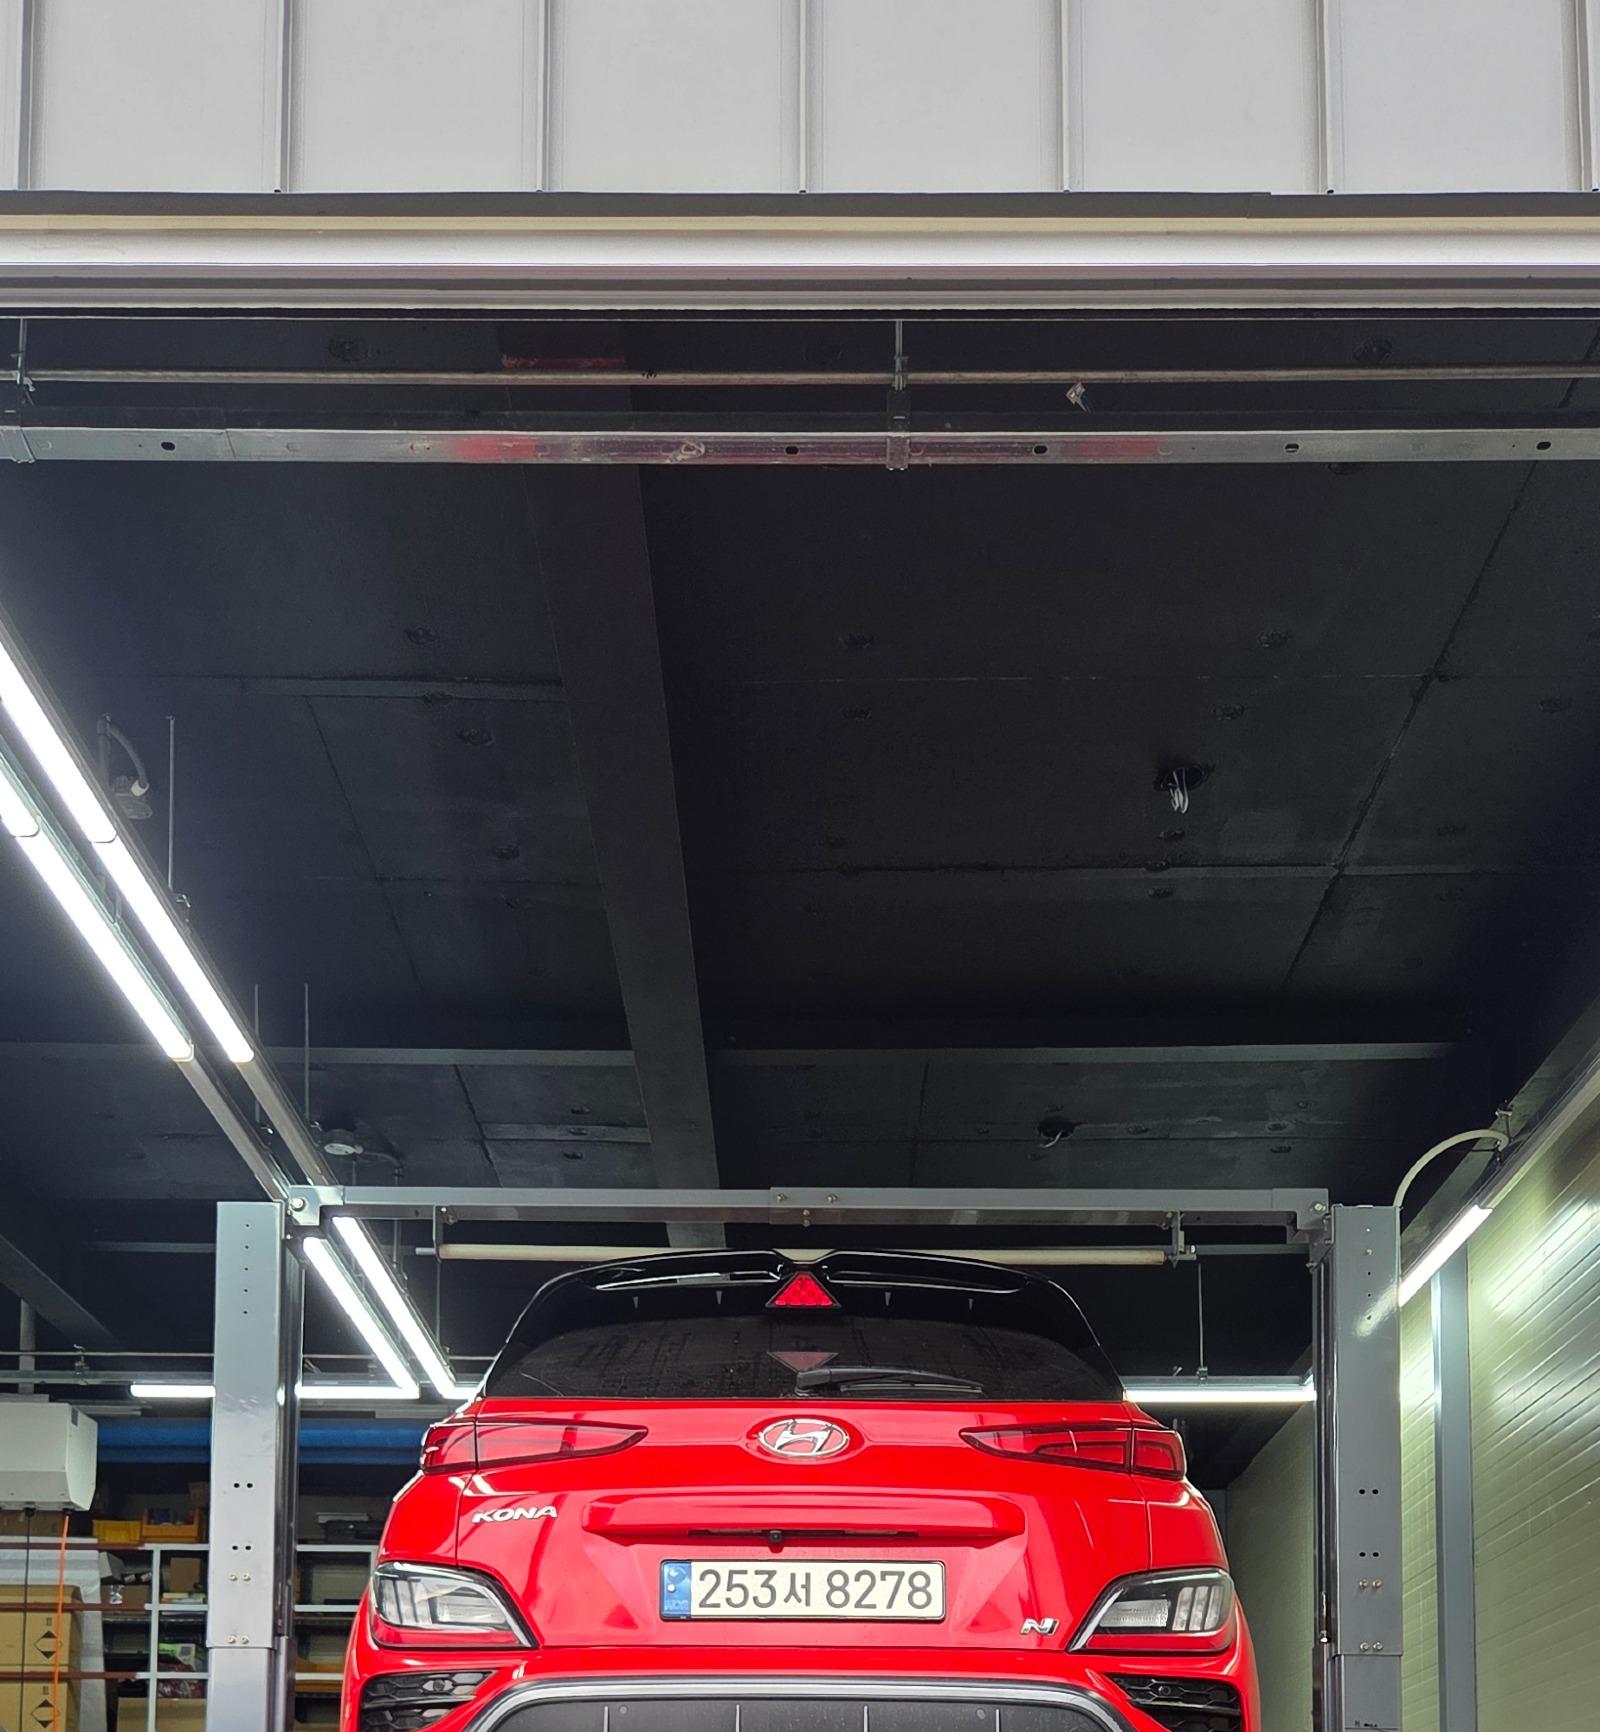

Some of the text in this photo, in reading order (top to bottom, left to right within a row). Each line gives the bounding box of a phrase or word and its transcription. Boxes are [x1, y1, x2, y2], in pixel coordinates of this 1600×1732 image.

[471, 1505, 558, 1524] KONA
[699, 1569, 932, 1609] 253서 8278
[1020, 1616, 1060, 1636] N
